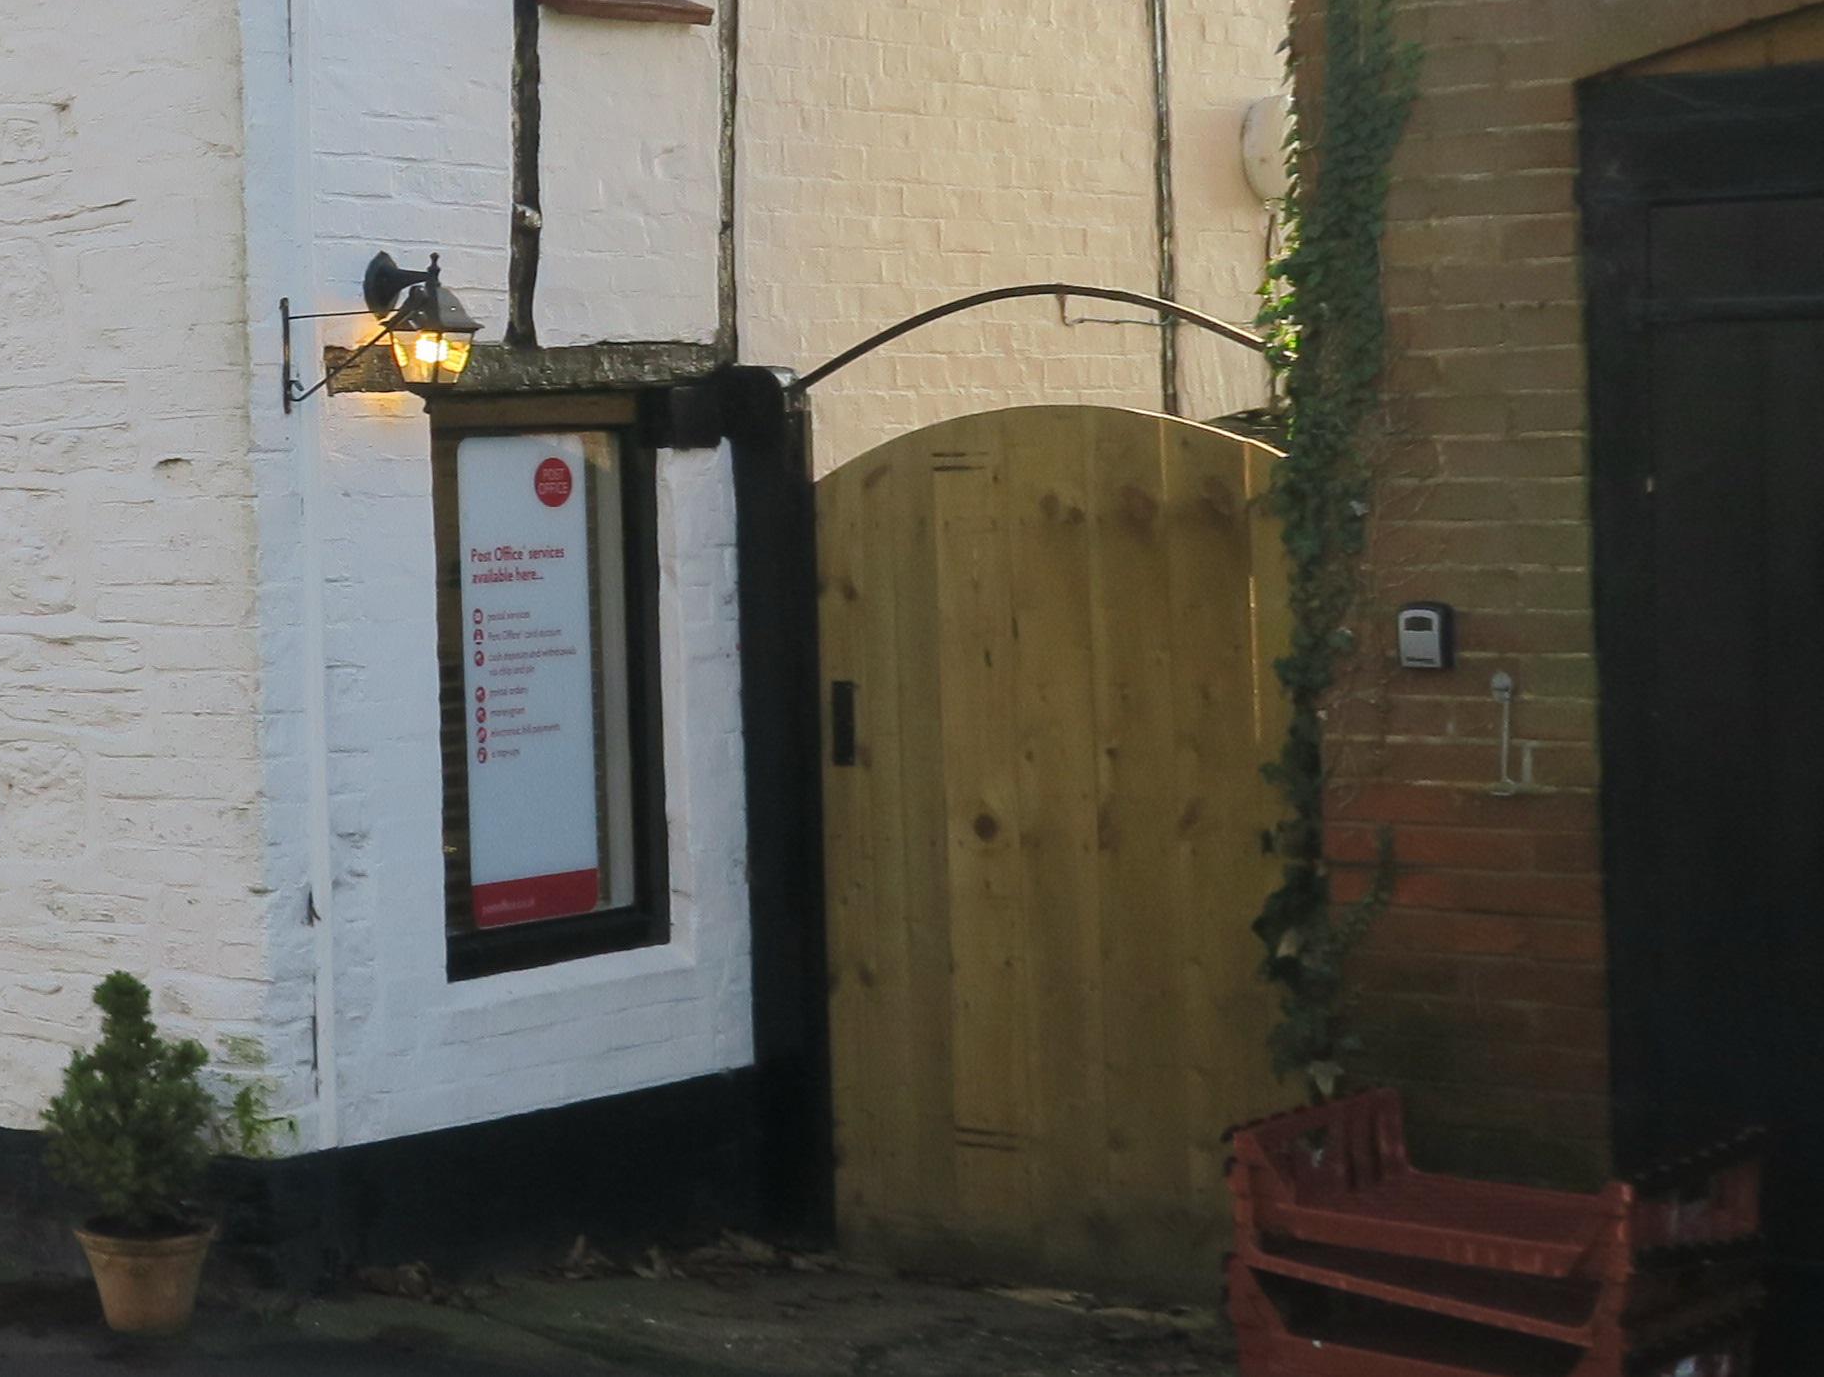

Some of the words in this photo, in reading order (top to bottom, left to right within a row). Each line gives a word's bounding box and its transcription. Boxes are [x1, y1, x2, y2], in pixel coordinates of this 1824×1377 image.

[543, 467, 565, 481] POST
[538, 481, 570, 494] OFFICE
[471, 548, 491, 562] Post
[494, 545, 523, 561] Office
[528, 546, 565, 560] services
[472, 567, 513, 584] available
